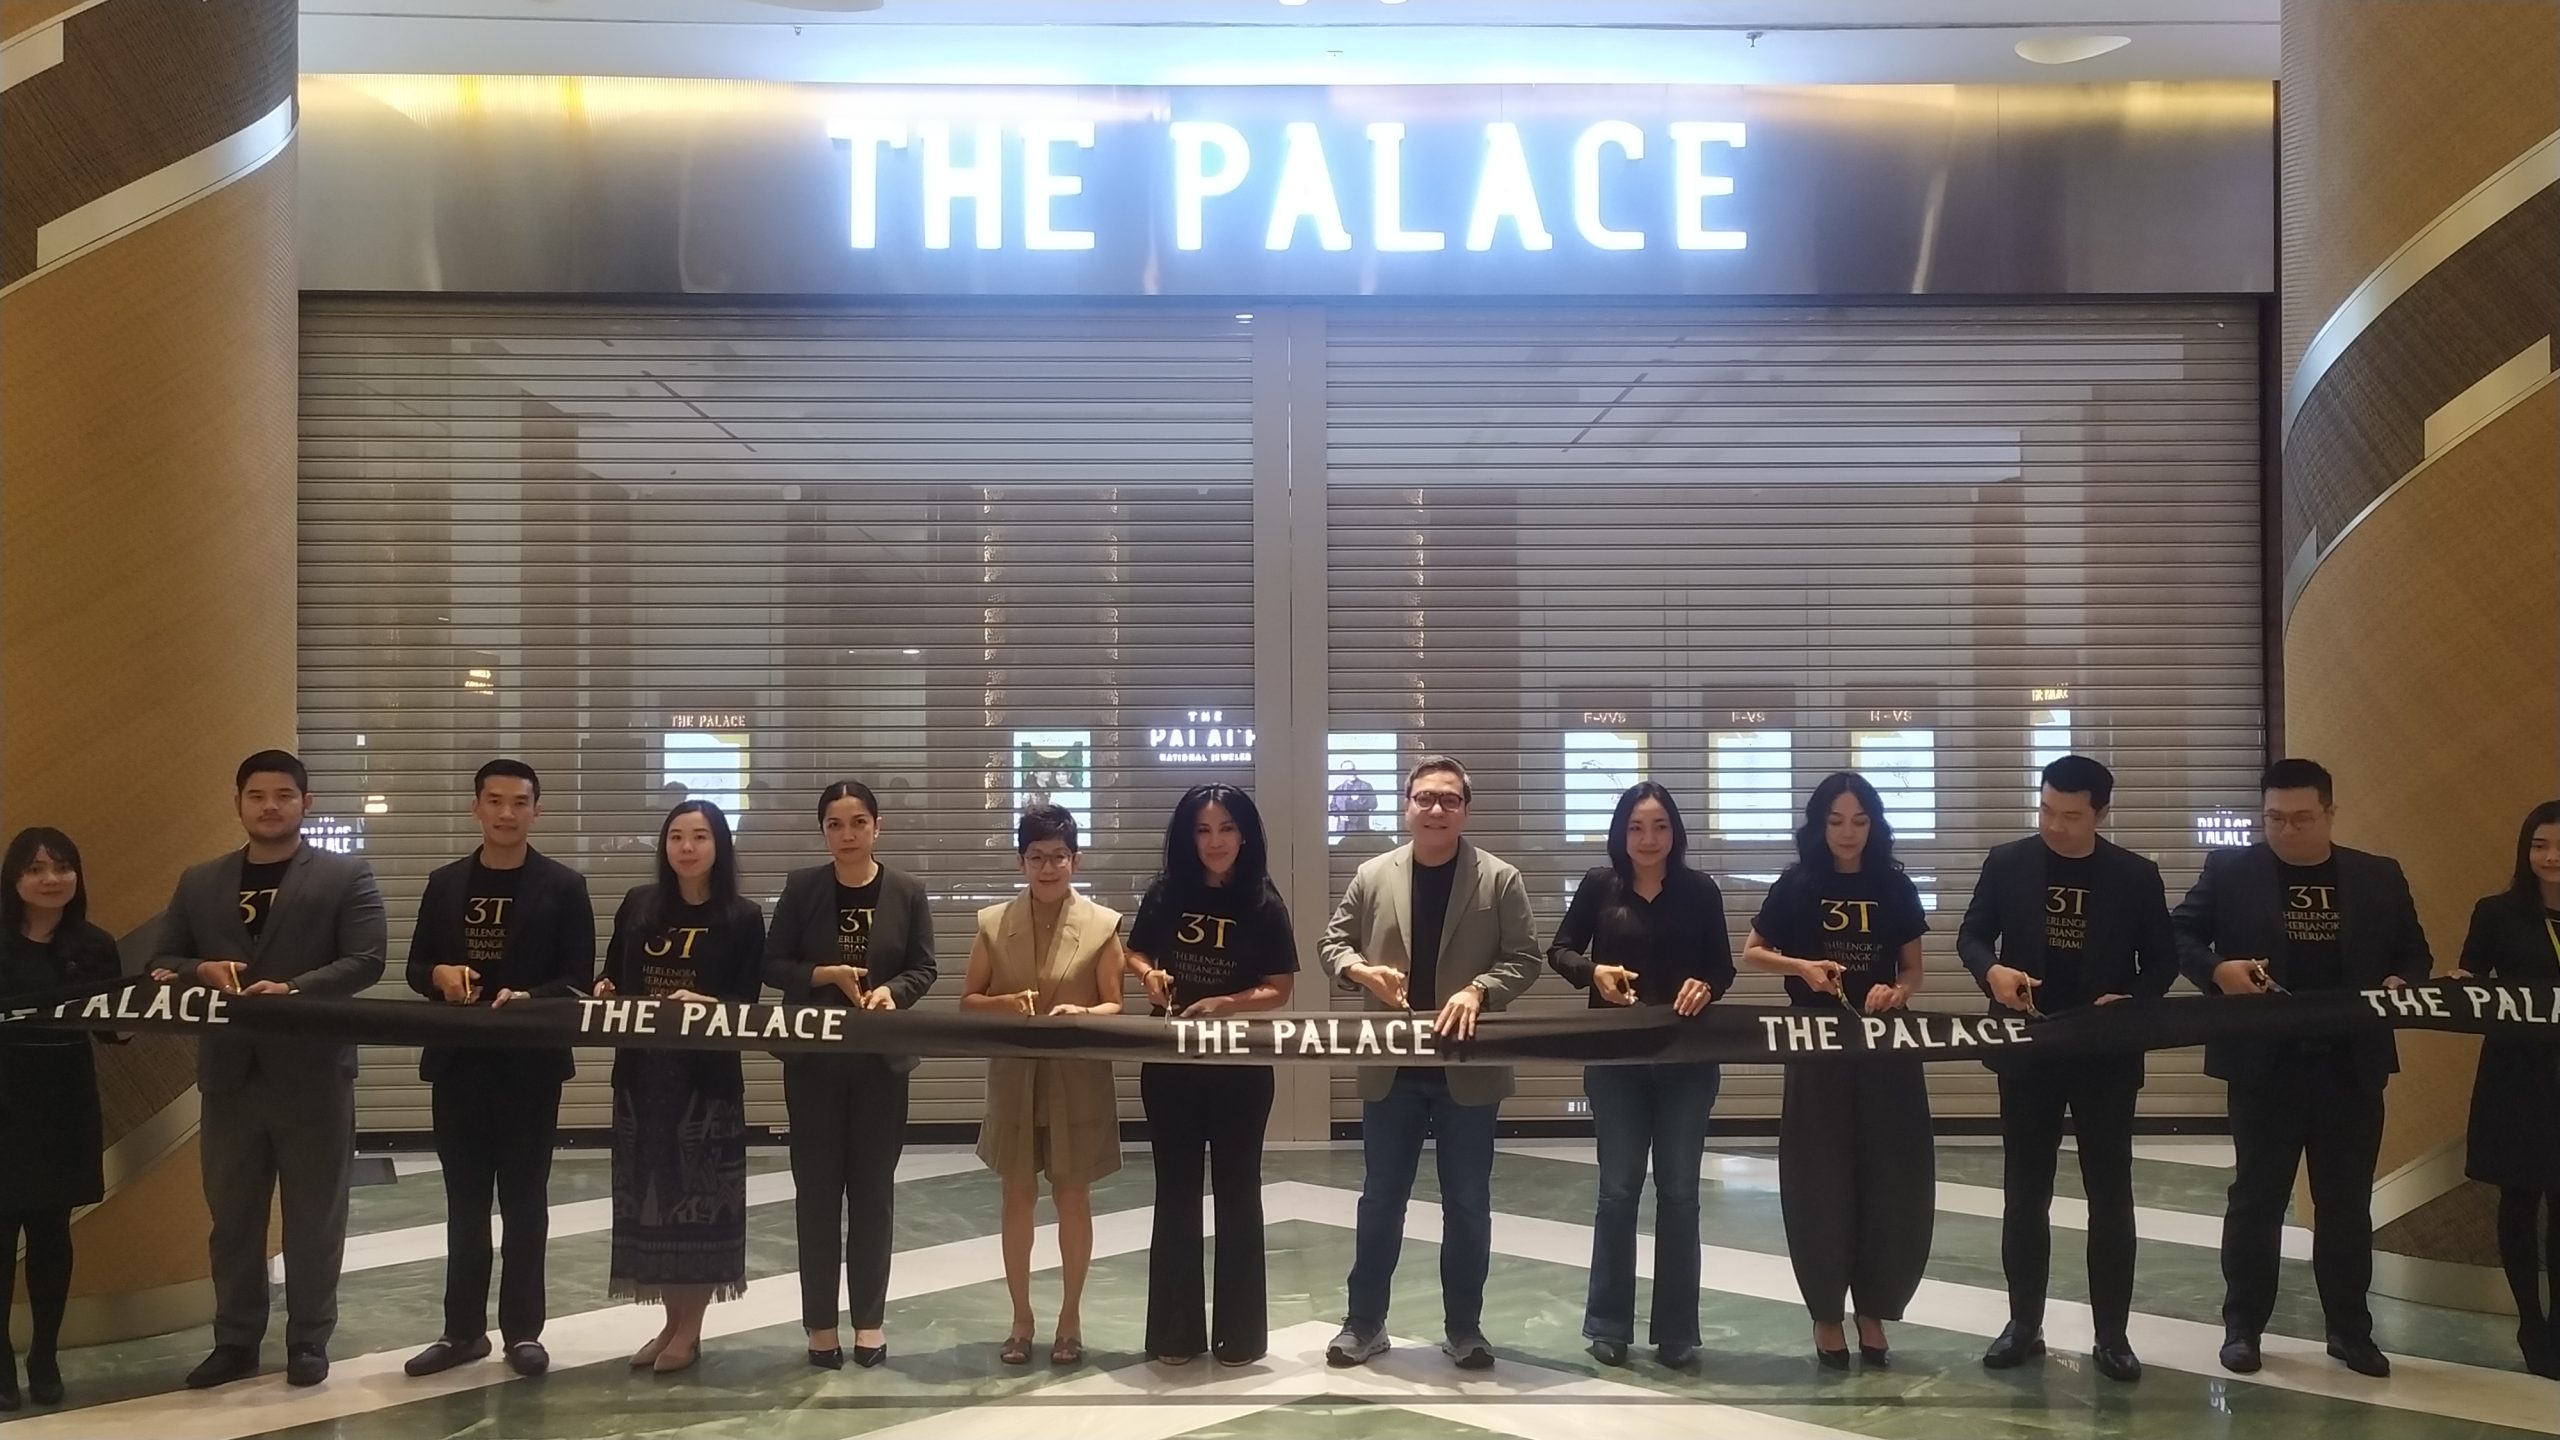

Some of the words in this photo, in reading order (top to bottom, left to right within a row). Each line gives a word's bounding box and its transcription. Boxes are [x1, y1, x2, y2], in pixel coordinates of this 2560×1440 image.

[827, 121, 1096, 250] THE
[1169, 121, 1748, 252] PALACE
[672, 714, 694, 727] THE
[699, 714, 746, 727] PALACE
[1187, 710, 1222, 722] THE
[464, 897, 513, 924] 3T
[2045, 886, 2091, 915] 3T
[2289, 886, 2335, 909] 3T
[1177, 912, 1237, 949] 3T
[1821, 899, 1878, 933] 3T
[2360, 987, 2451, 1017] THE
[578, 1000, 660, 1033] THE
[680, 1002, 847, 1041] PALACE
[1758, 1016, 1843, 1051] THE
[1861, 1016, 2033, 1049] PALACE
[1171, 1020, 1250, 1053] THE
[1272, 1019, 1436, 1055] PALACE
